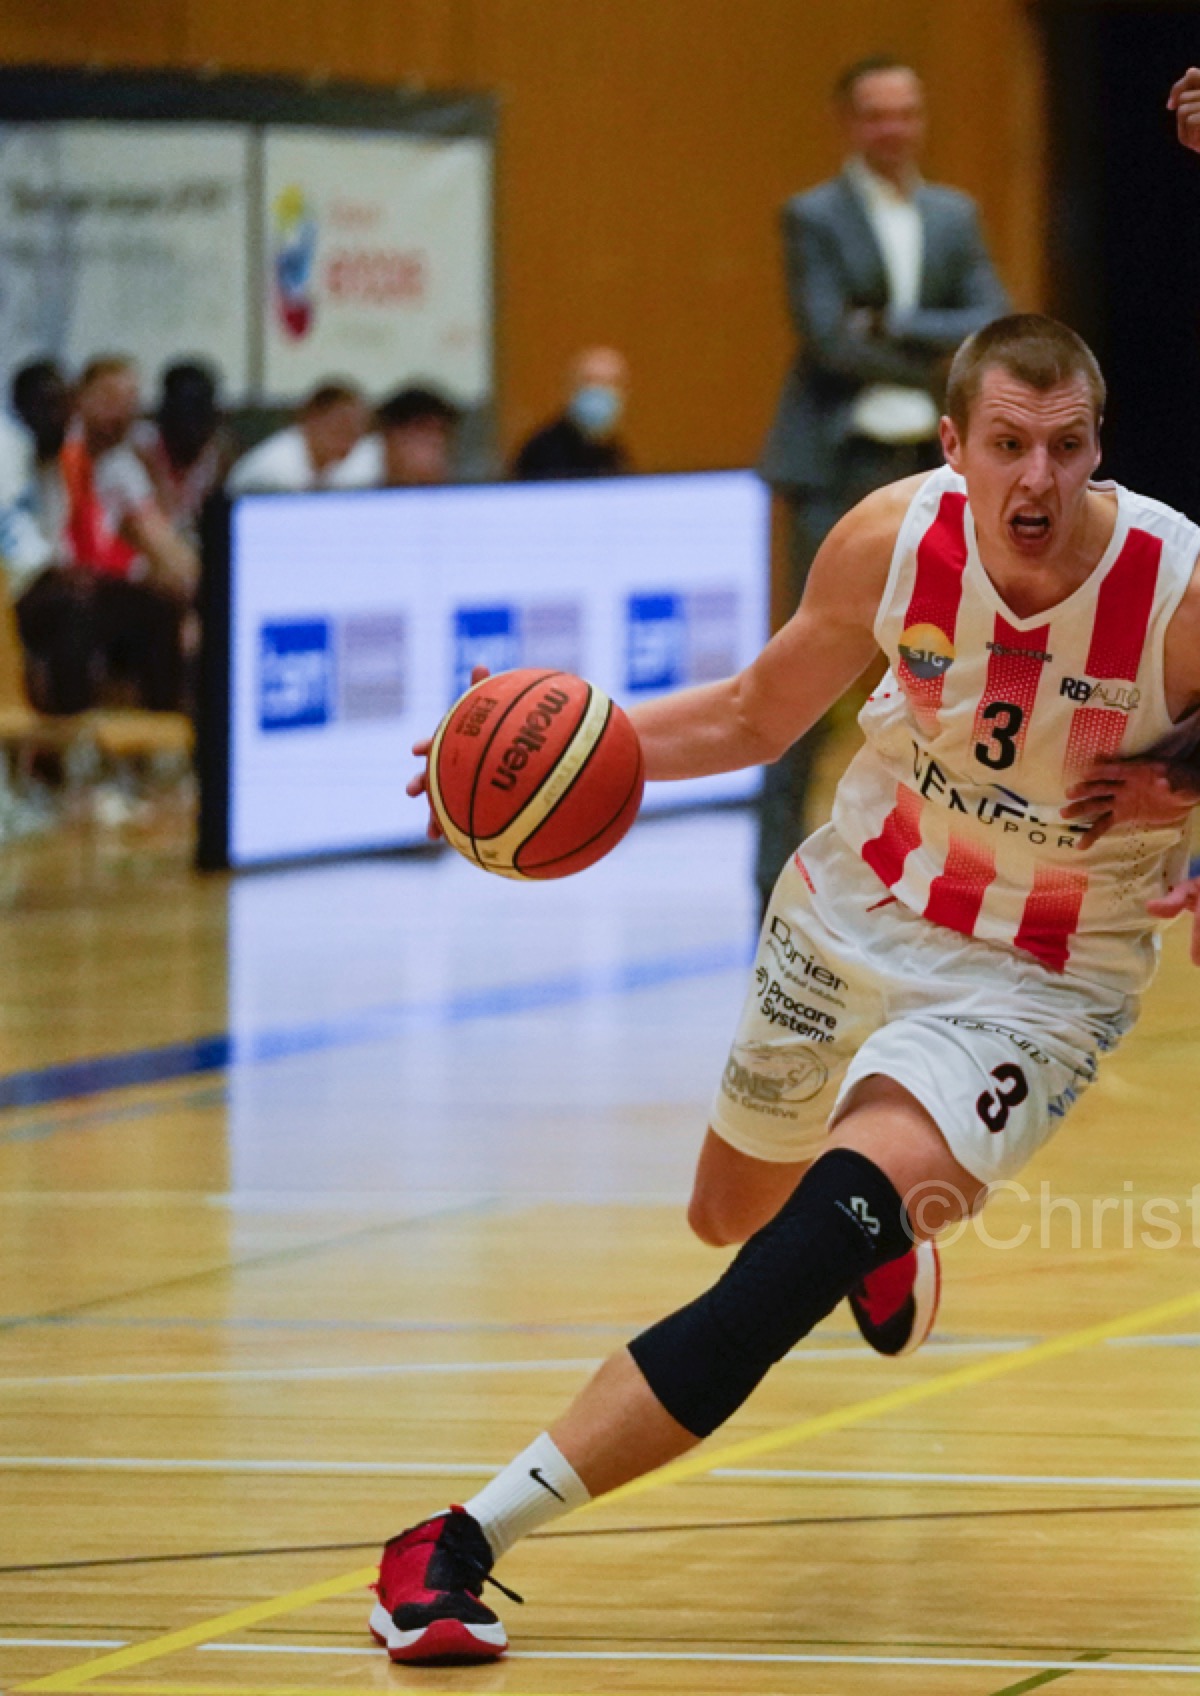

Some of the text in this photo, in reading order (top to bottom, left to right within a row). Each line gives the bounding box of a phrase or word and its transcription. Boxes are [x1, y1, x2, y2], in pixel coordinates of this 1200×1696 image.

[490, 688, 569, 791] molten
[974, 702, 1024, 771] 3
[768, 980, 837, 1030] Procare
[976, 1062, 1029, 1134] 3
